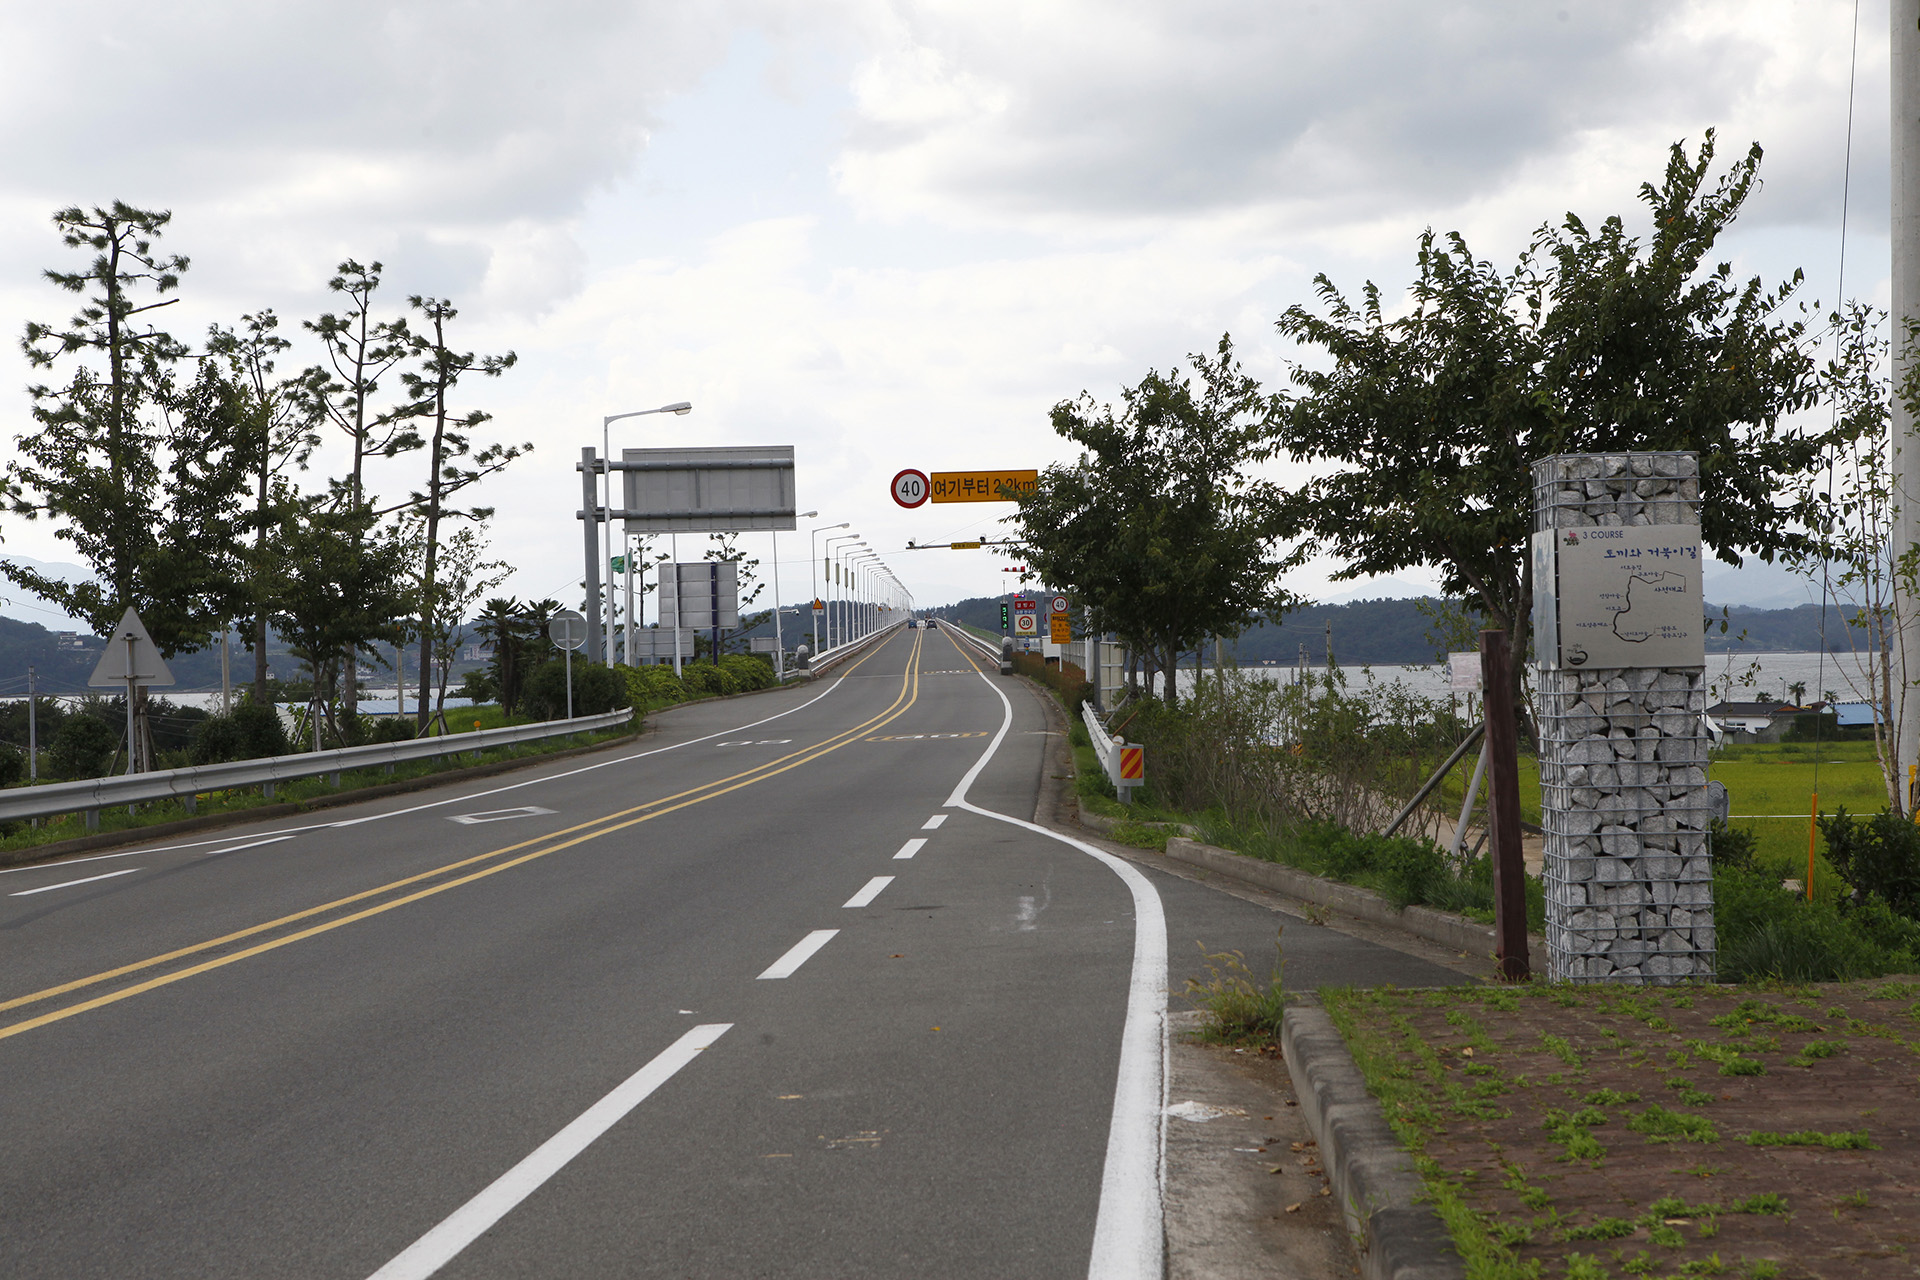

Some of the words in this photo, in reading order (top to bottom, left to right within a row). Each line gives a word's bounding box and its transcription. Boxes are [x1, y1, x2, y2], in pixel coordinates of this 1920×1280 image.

[901, 481, 920, 497] 40
[934, 477, 990, 497] 여기부터
[1582, 531, 1588, 540] 3
[1590, 530, 1624, 539] COURSE
[1603, 548, 1642, 559] 토끼와
[1647, 545, 1697, 560] 거북이길
[1055, 600, 1065, 609] 40
[1021, 619, 1031, 627] 30
